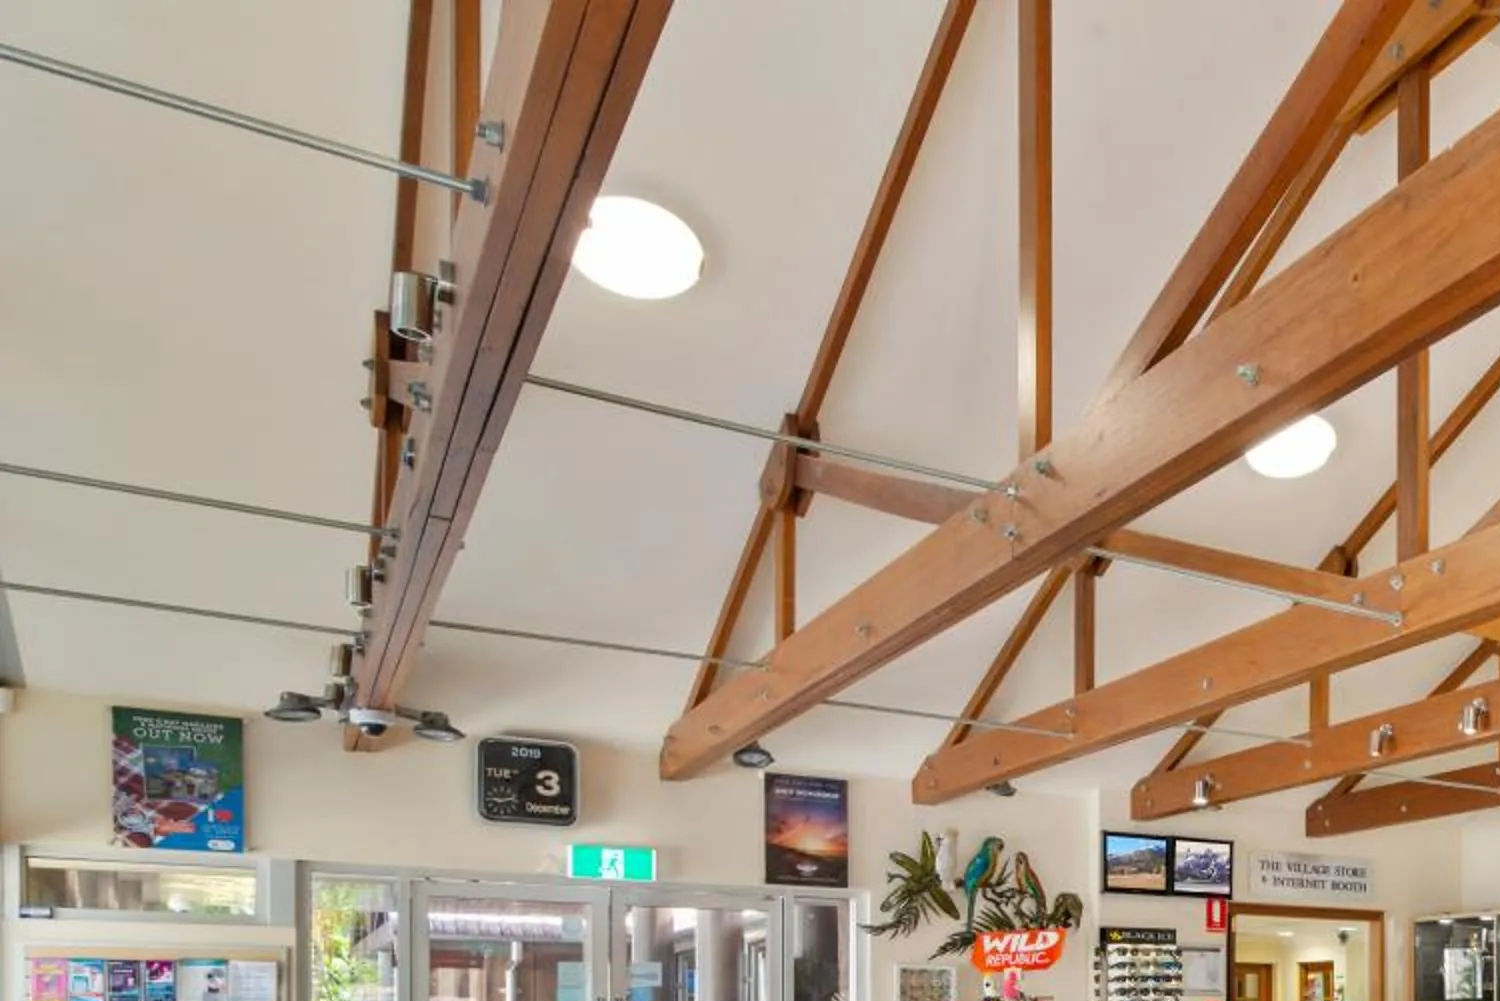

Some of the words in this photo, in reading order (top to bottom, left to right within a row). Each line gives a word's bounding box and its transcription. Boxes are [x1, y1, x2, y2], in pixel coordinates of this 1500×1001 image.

[132, 727, 172, 739] OUT
[179, 731, 224, 744] NOW
[486, 767, 512, 779] TUE
[535, 769, 561, 797] 3
[1259, 859, 1281, 871] THE
[1287, 862, 1330, 874] VILLAGE
[1334, 865, 1367, 878] STORE
[1273, 876, 1328, 889] INTERNET
[1331, 880, 1367, 893] BOOTH
[983, 931, 1059, 953] WILD
